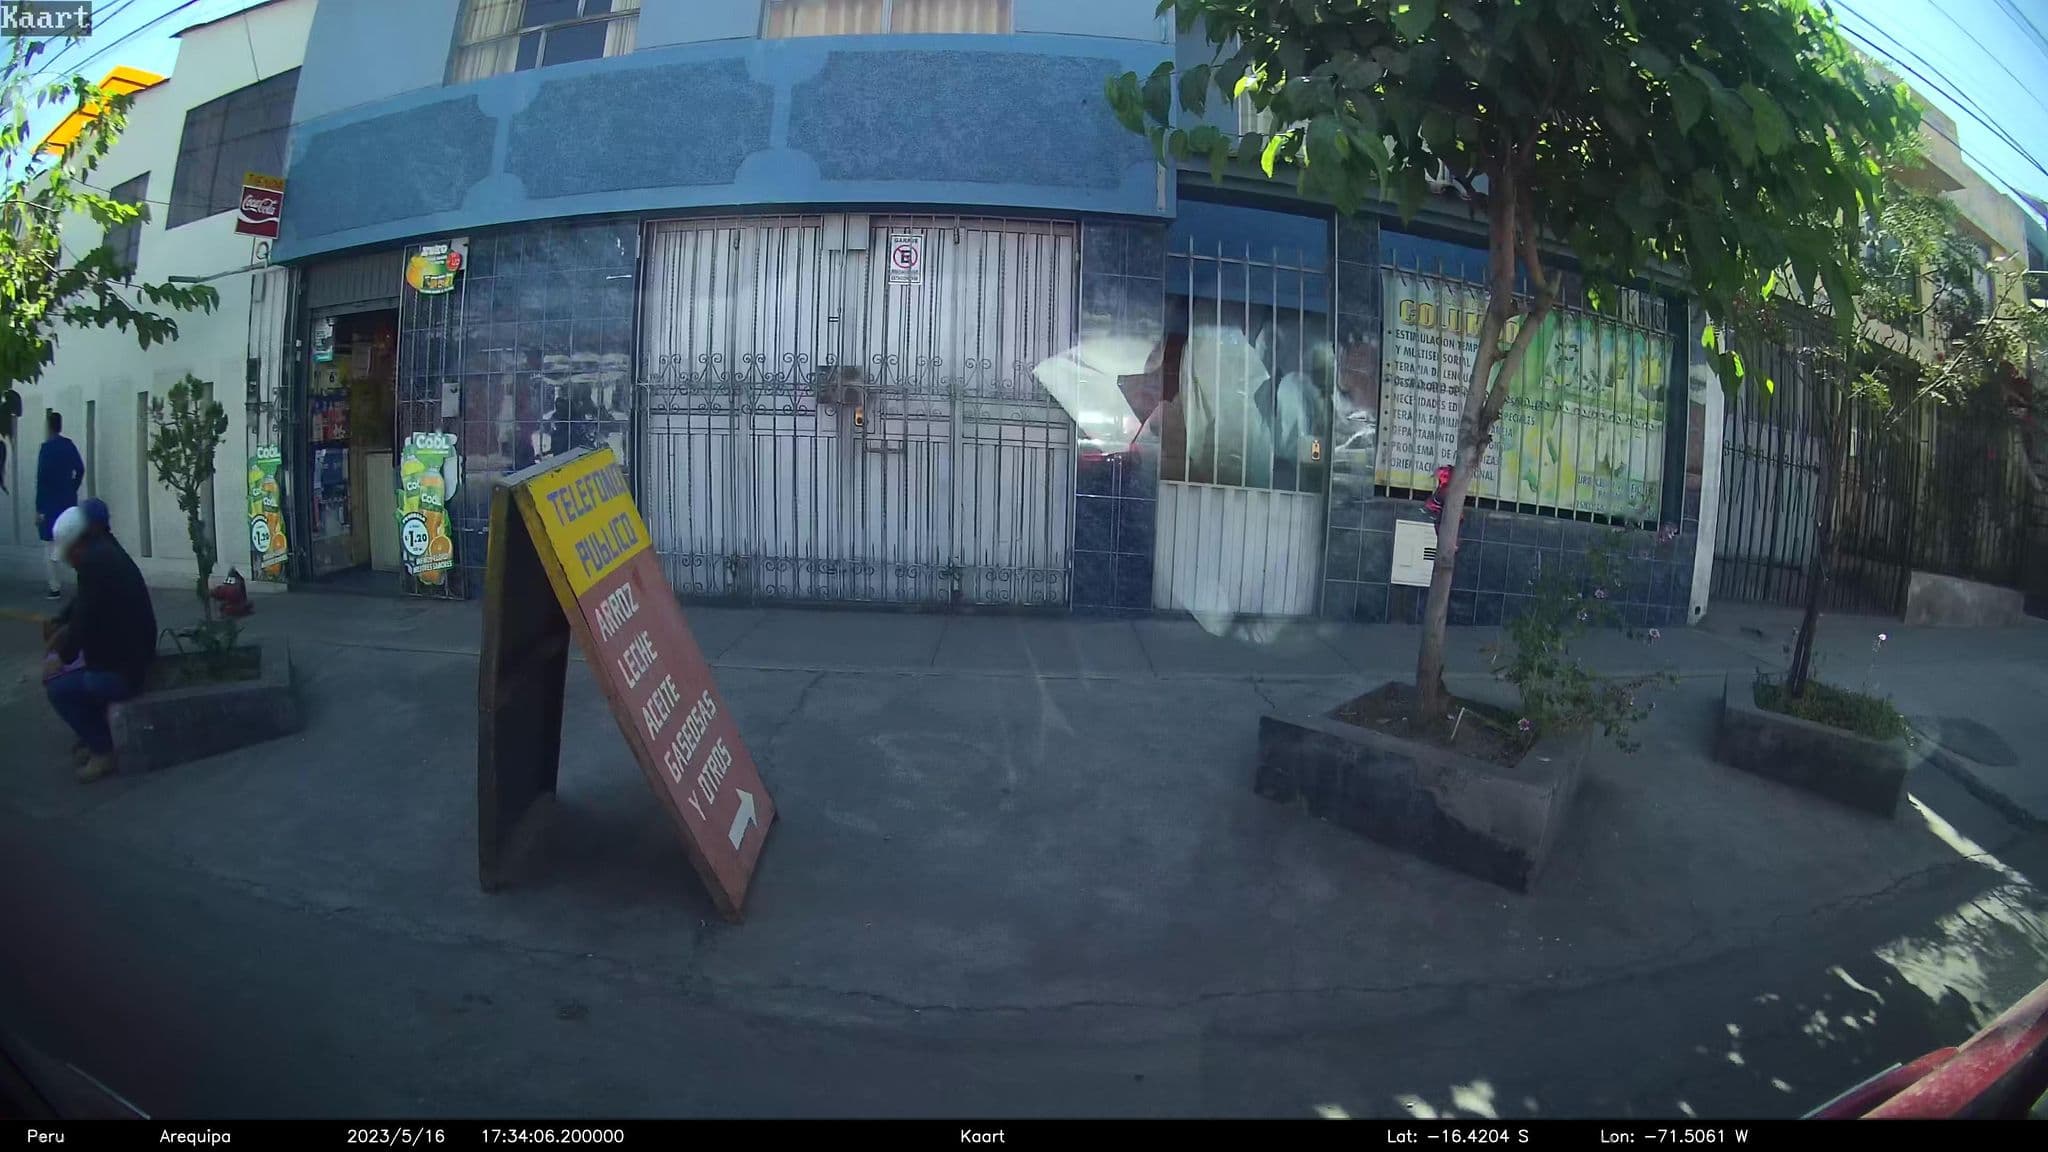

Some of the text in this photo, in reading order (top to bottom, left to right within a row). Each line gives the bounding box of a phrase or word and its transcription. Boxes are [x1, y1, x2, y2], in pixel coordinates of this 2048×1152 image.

[1395, 345, 1401, 355] Y
[594, 582, 640, 642] ARROZ
[617, 630, 658, 689] LECHE
[642, 673, 681, 741] ACEITE
[663, 689, 717, 784] GASEOSAS
[688, 737, 733, 821] Y OTROS
